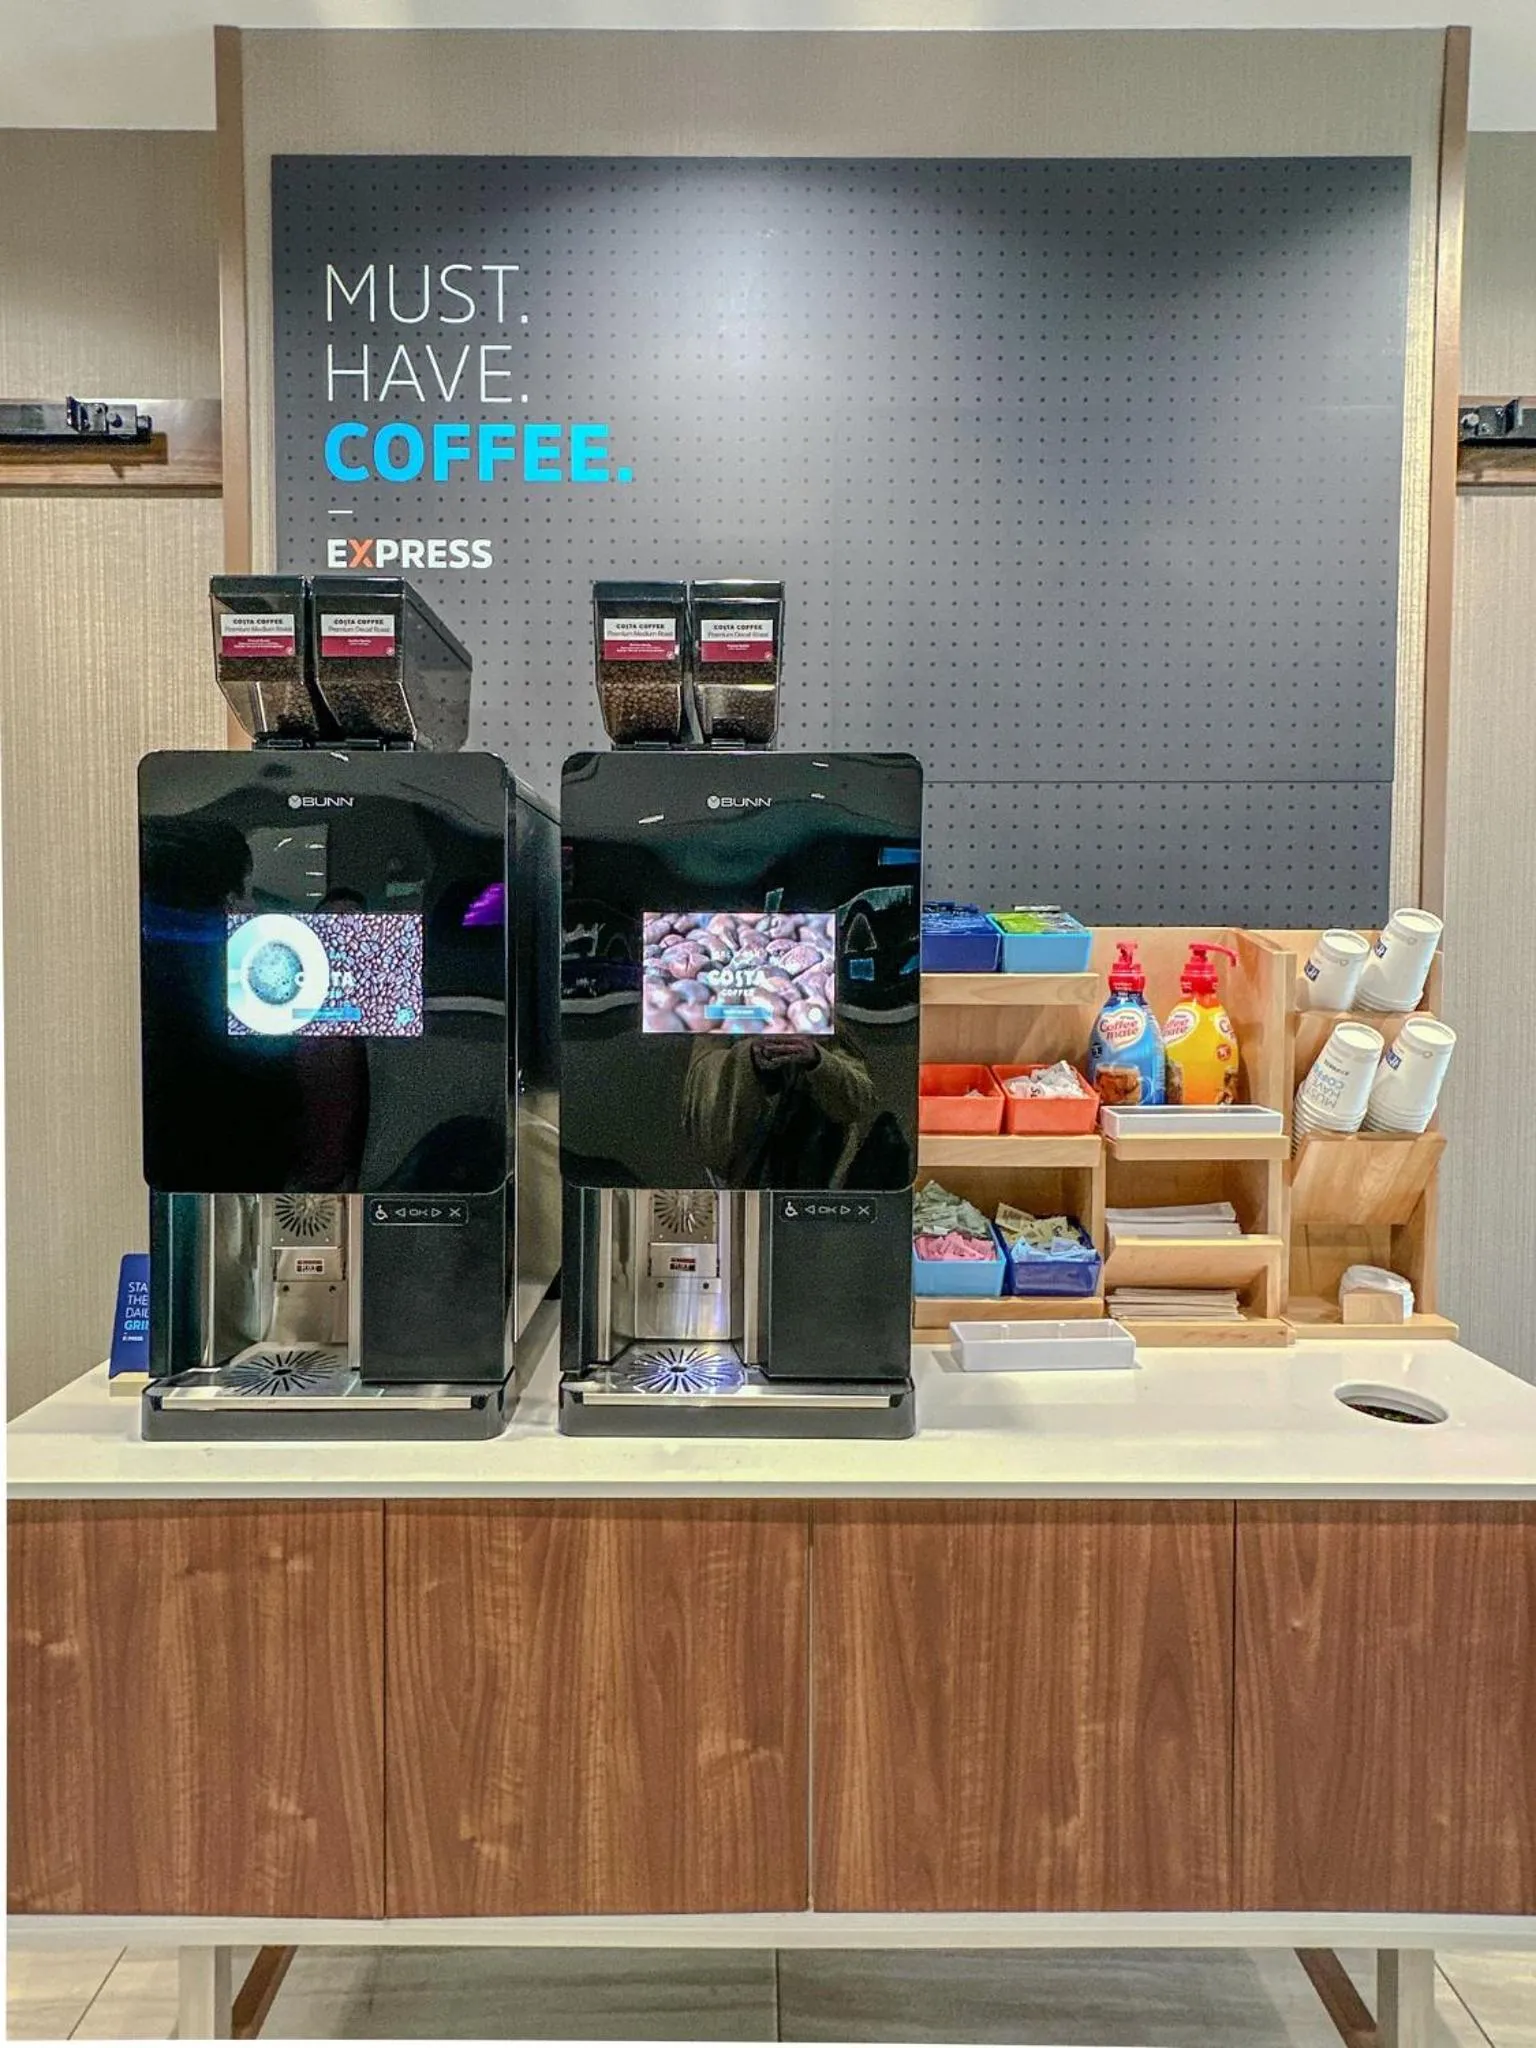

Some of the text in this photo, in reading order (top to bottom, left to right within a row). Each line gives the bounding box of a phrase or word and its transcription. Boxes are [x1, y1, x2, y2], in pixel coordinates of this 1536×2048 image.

[326, 263, 529, 324] MUST.
[327, 344, 529, 403] HAVE.
[324, 422, 634, 483] COFFEE.
[327, 538, 493, 569] EXPRESS
[302, 796, 354, 807] BUNN
[721, 797, 772, 807] BUNN
[707, 969, 768, 988] COSTA
[1100, 1019, 1138, 1033] Coffee
[1106, 1028, 1139, 1041] mate
[410, 1208, 429, 1217] OK
[818, 1206, 837, 1214] OK
[128, 1294, 149, 1306] THE
